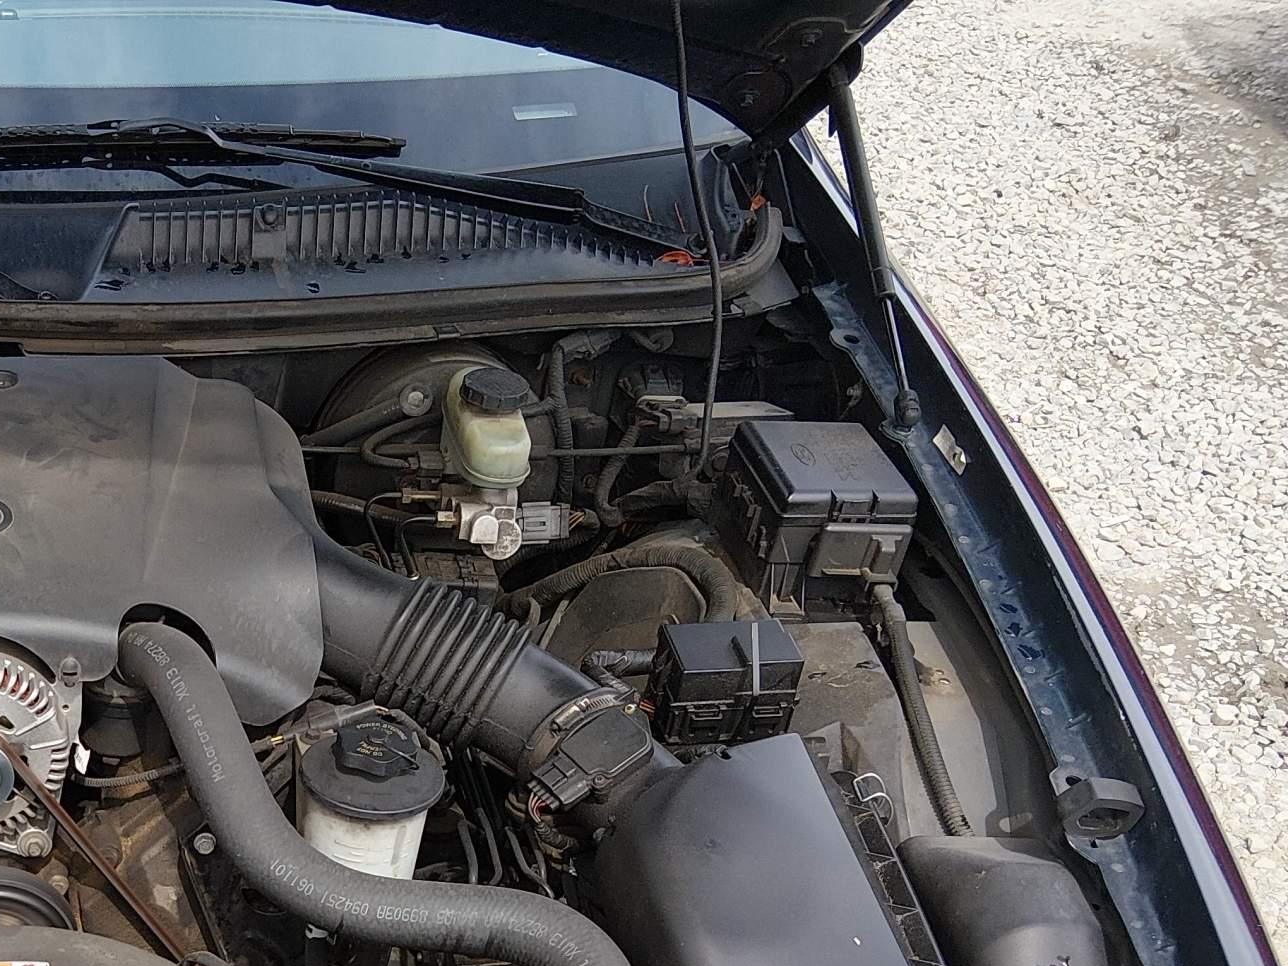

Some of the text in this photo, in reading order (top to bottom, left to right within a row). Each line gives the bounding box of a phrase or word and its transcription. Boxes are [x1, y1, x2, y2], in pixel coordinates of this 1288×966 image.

[185, 704, 226, 784] Motorcraft
[269, 857, 315, 897] 061101
[320, 891, 369, 916] 094251
